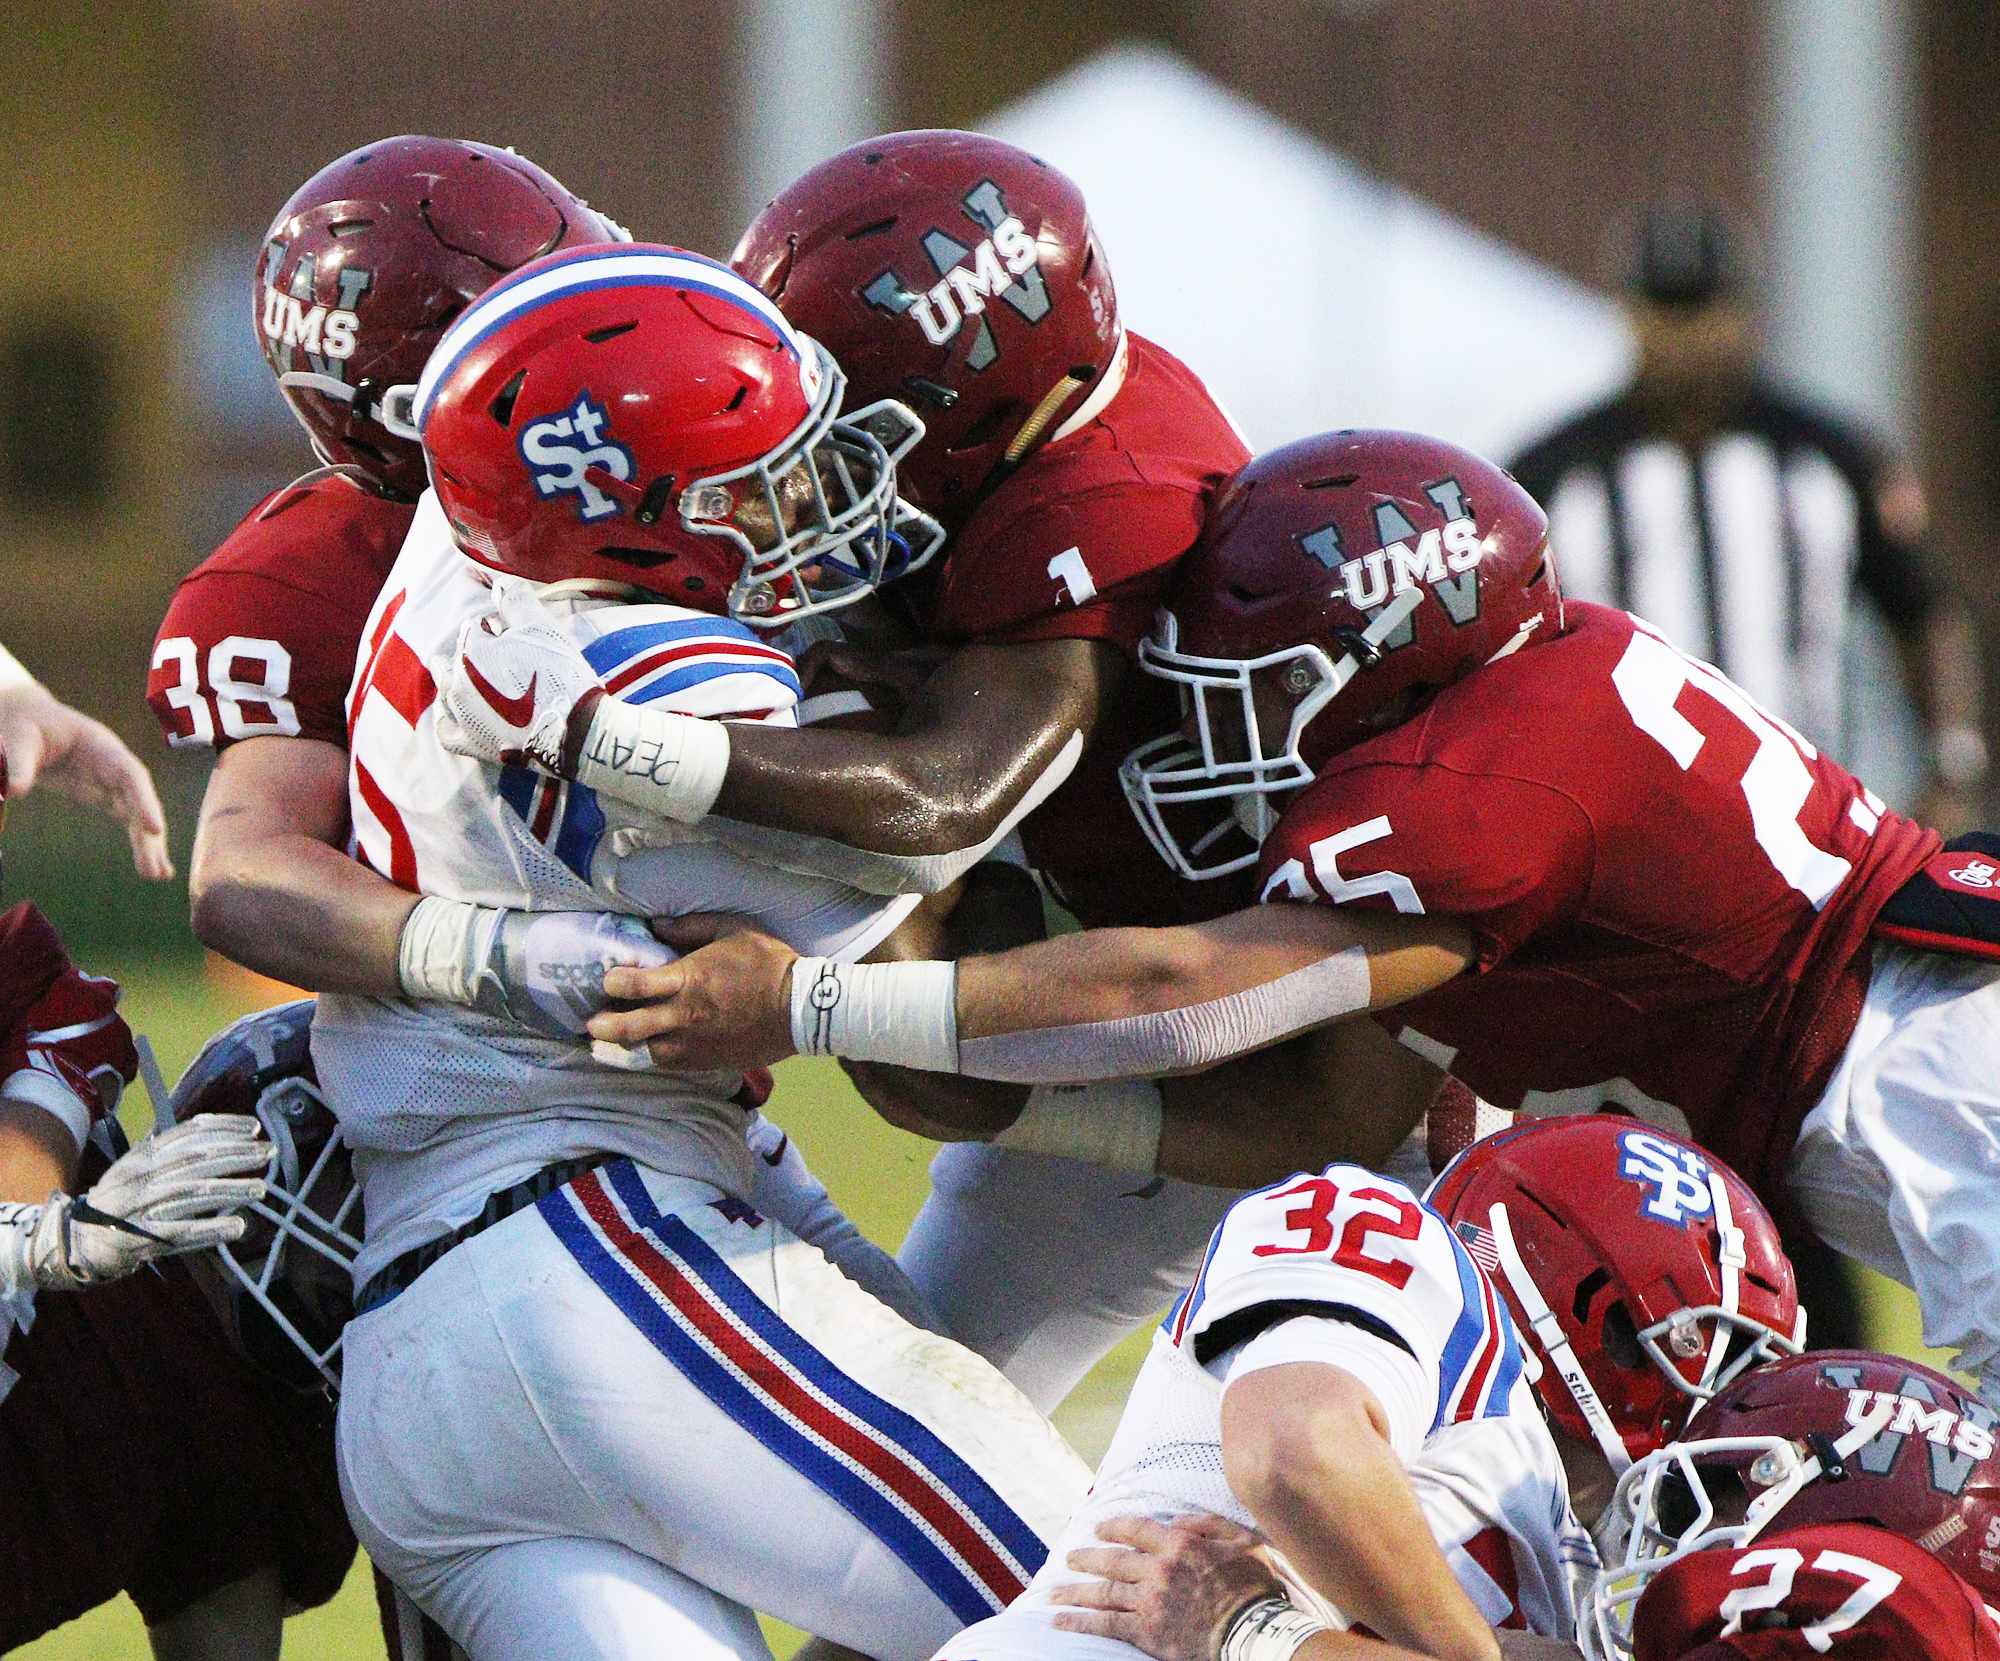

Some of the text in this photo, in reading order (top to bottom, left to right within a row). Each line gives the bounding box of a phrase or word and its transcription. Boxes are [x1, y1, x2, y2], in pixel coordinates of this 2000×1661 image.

[261, 285, 361, 360] UMS
[908, 217, 1038, 346] UMS
[1047, 545, 1098, 606] 1
[1339, 516, 1483, 611] UMS
[151, 635, 302, 749] 38
[1251, 1178, 1424, 1291] 32
[1844, 1388, 1997, 1461] UMS
[1718, 1548, 1904, 1655] 27
